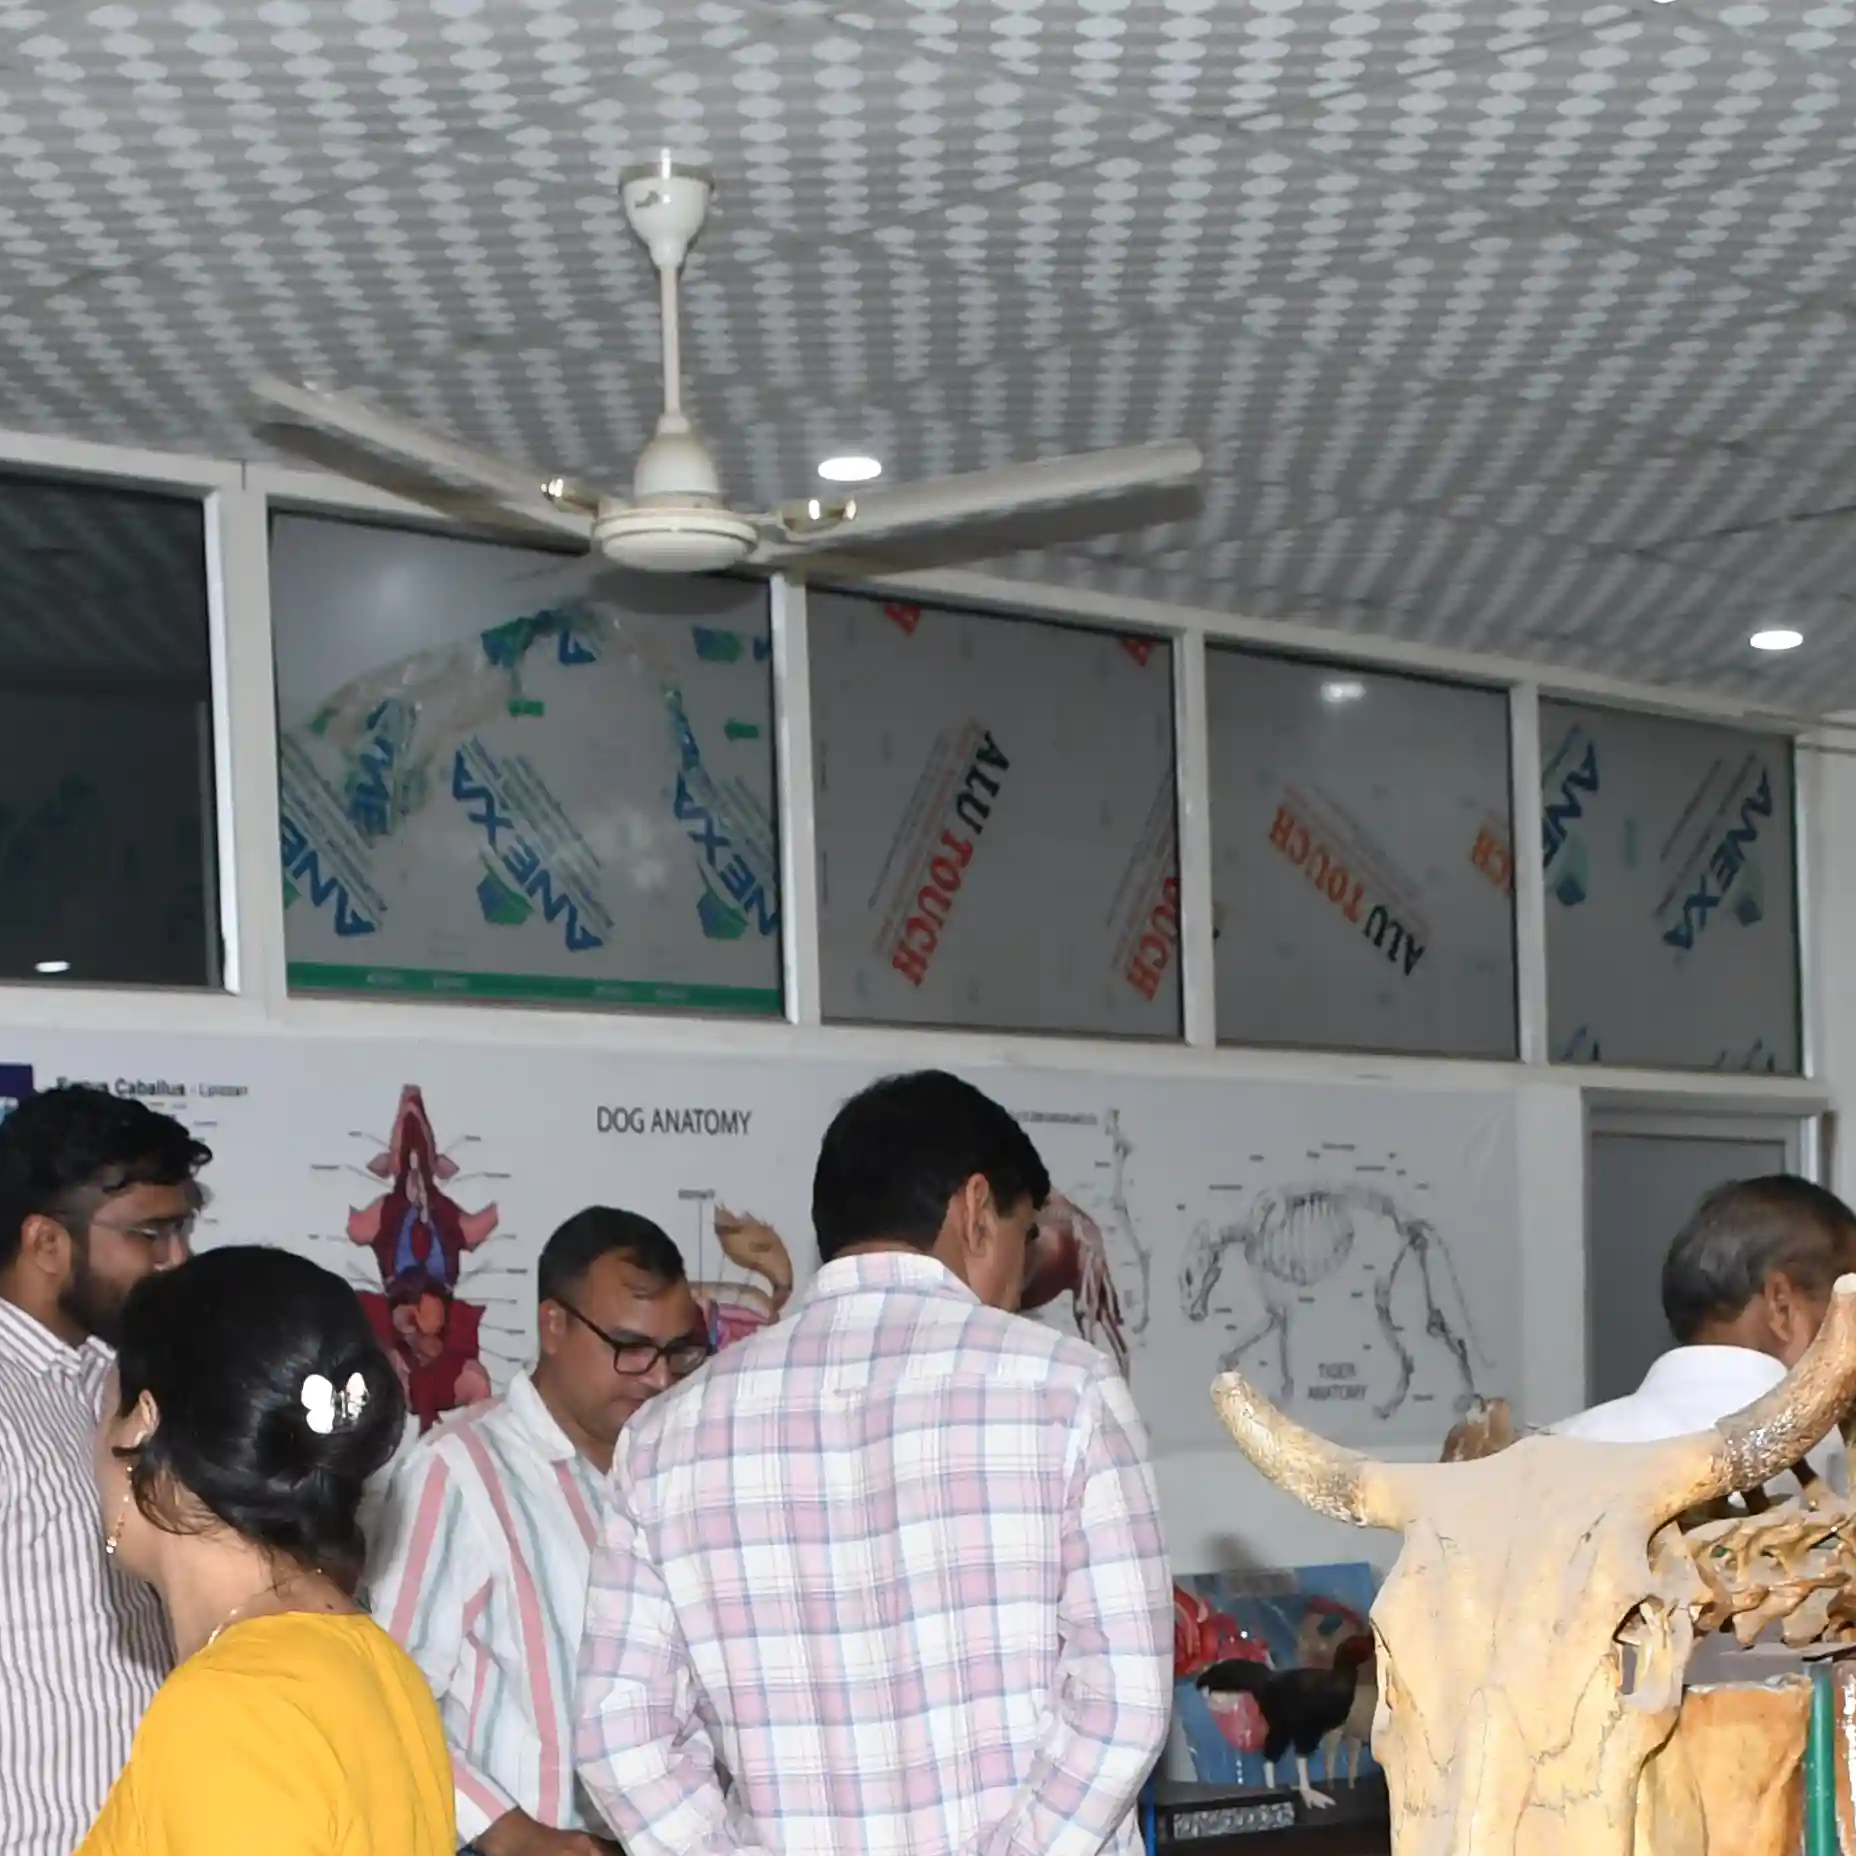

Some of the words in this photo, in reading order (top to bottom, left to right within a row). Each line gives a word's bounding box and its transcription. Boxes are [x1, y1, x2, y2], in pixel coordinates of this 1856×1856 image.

[956, 730, 1010, 835] ALU
[673, 770, 778, 936] NEXA
[892, 828, 974, 987] TOUCH
[1362, 904, 1426, 977] ALU
[597, 1105, 645, 1134] DOG
[650, 1107, 752, 1136] ANATOMY
